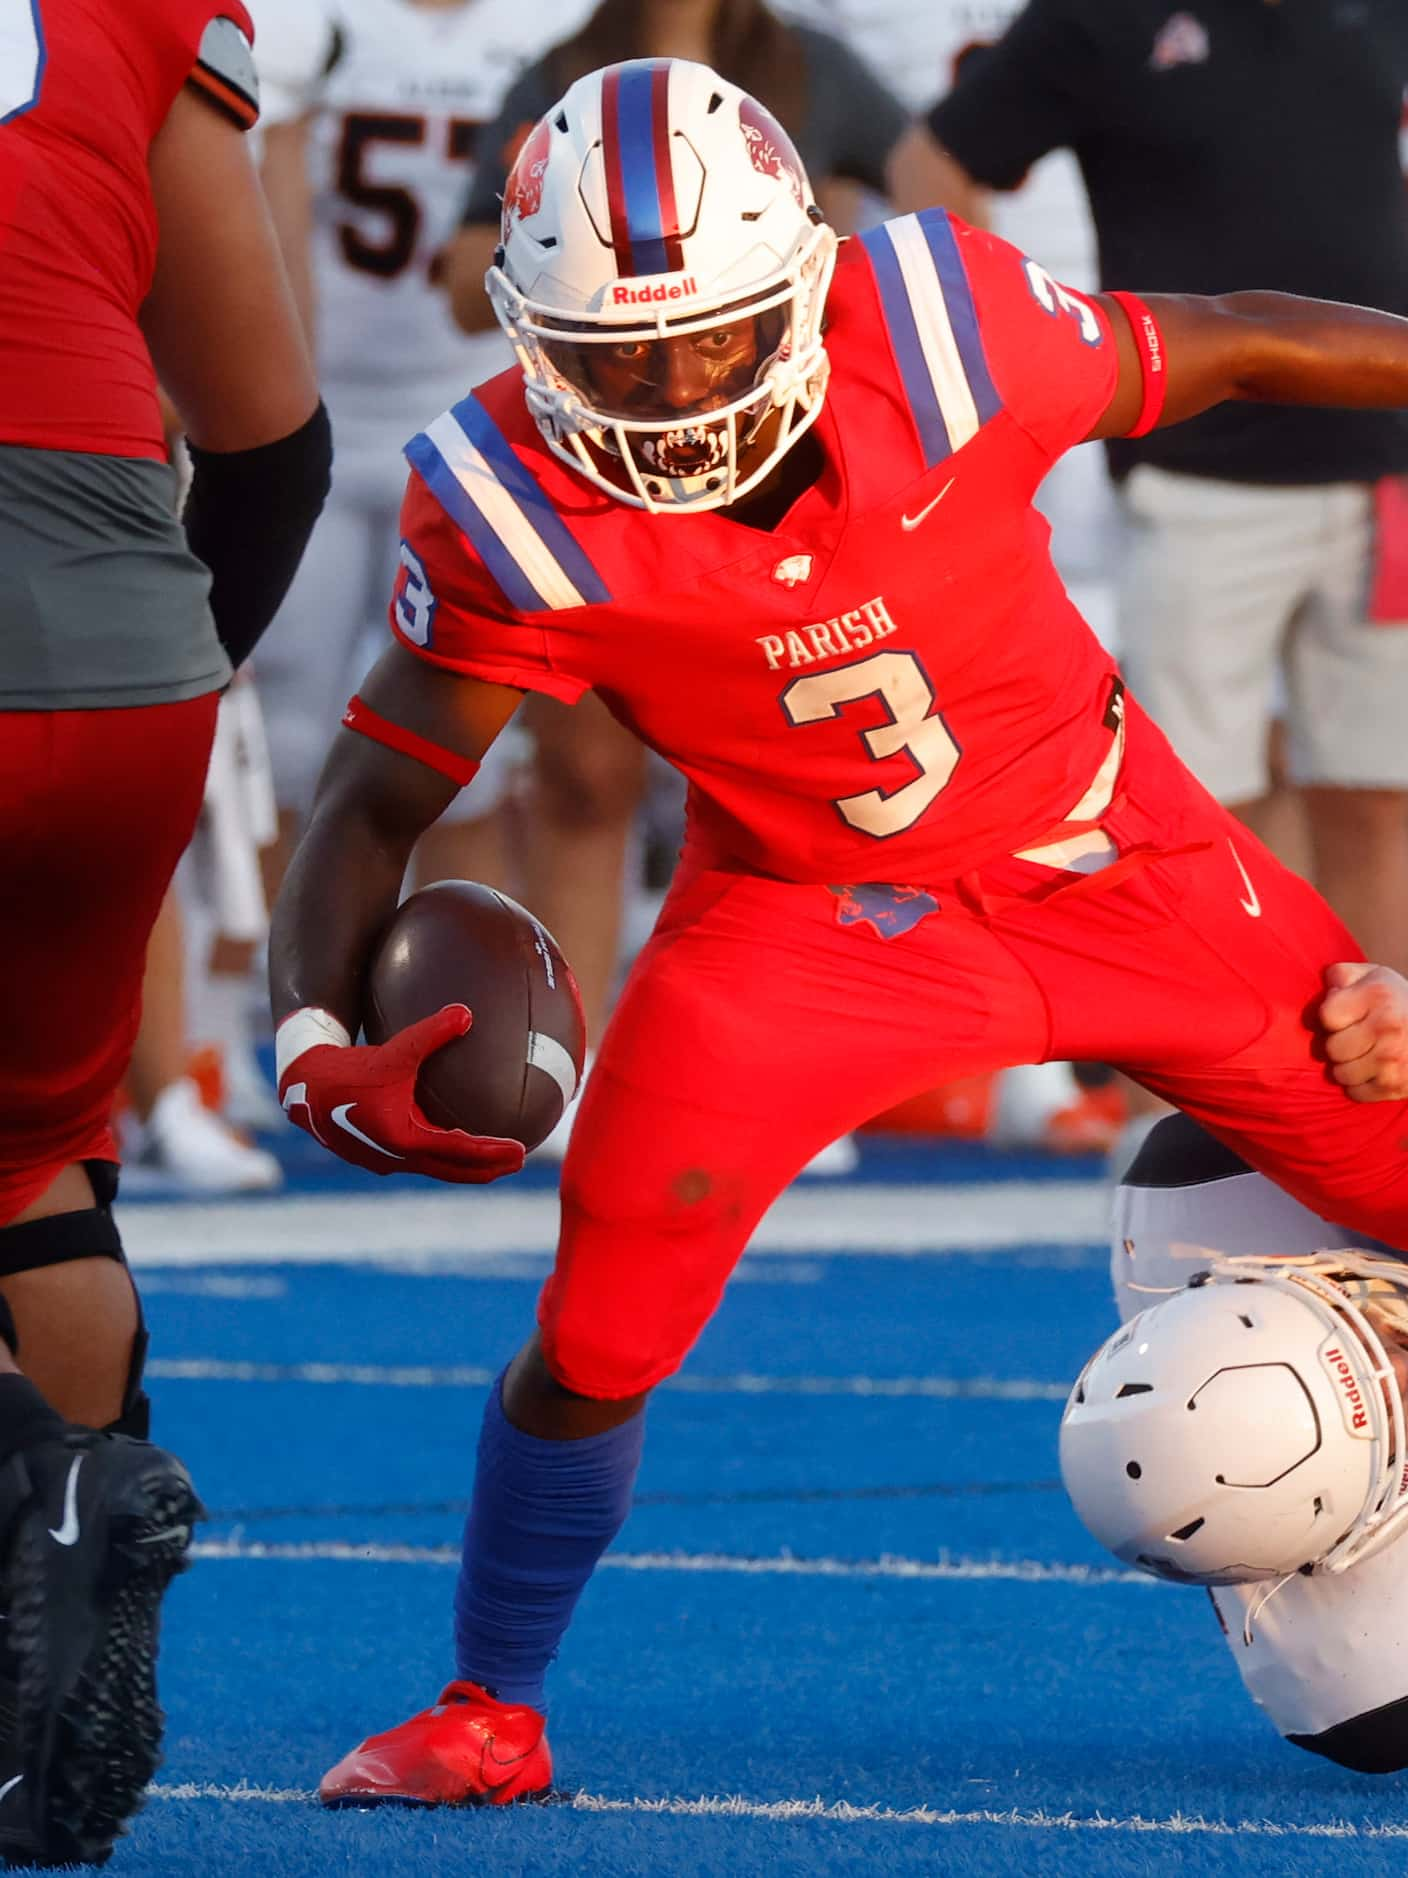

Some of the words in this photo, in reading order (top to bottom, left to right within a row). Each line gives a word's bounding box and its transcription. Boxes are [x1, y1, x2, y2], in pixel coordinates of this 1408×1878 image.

[612, 276, 698, 305] Riddell
[1021, 255, 1104, 348] 3
[395, 538, 438, 650] 3
[755, 596, 898, 670] PARISH
[777, 648, 963, 843] 3
[1325, 1348, 1368, 1430] Riddell
